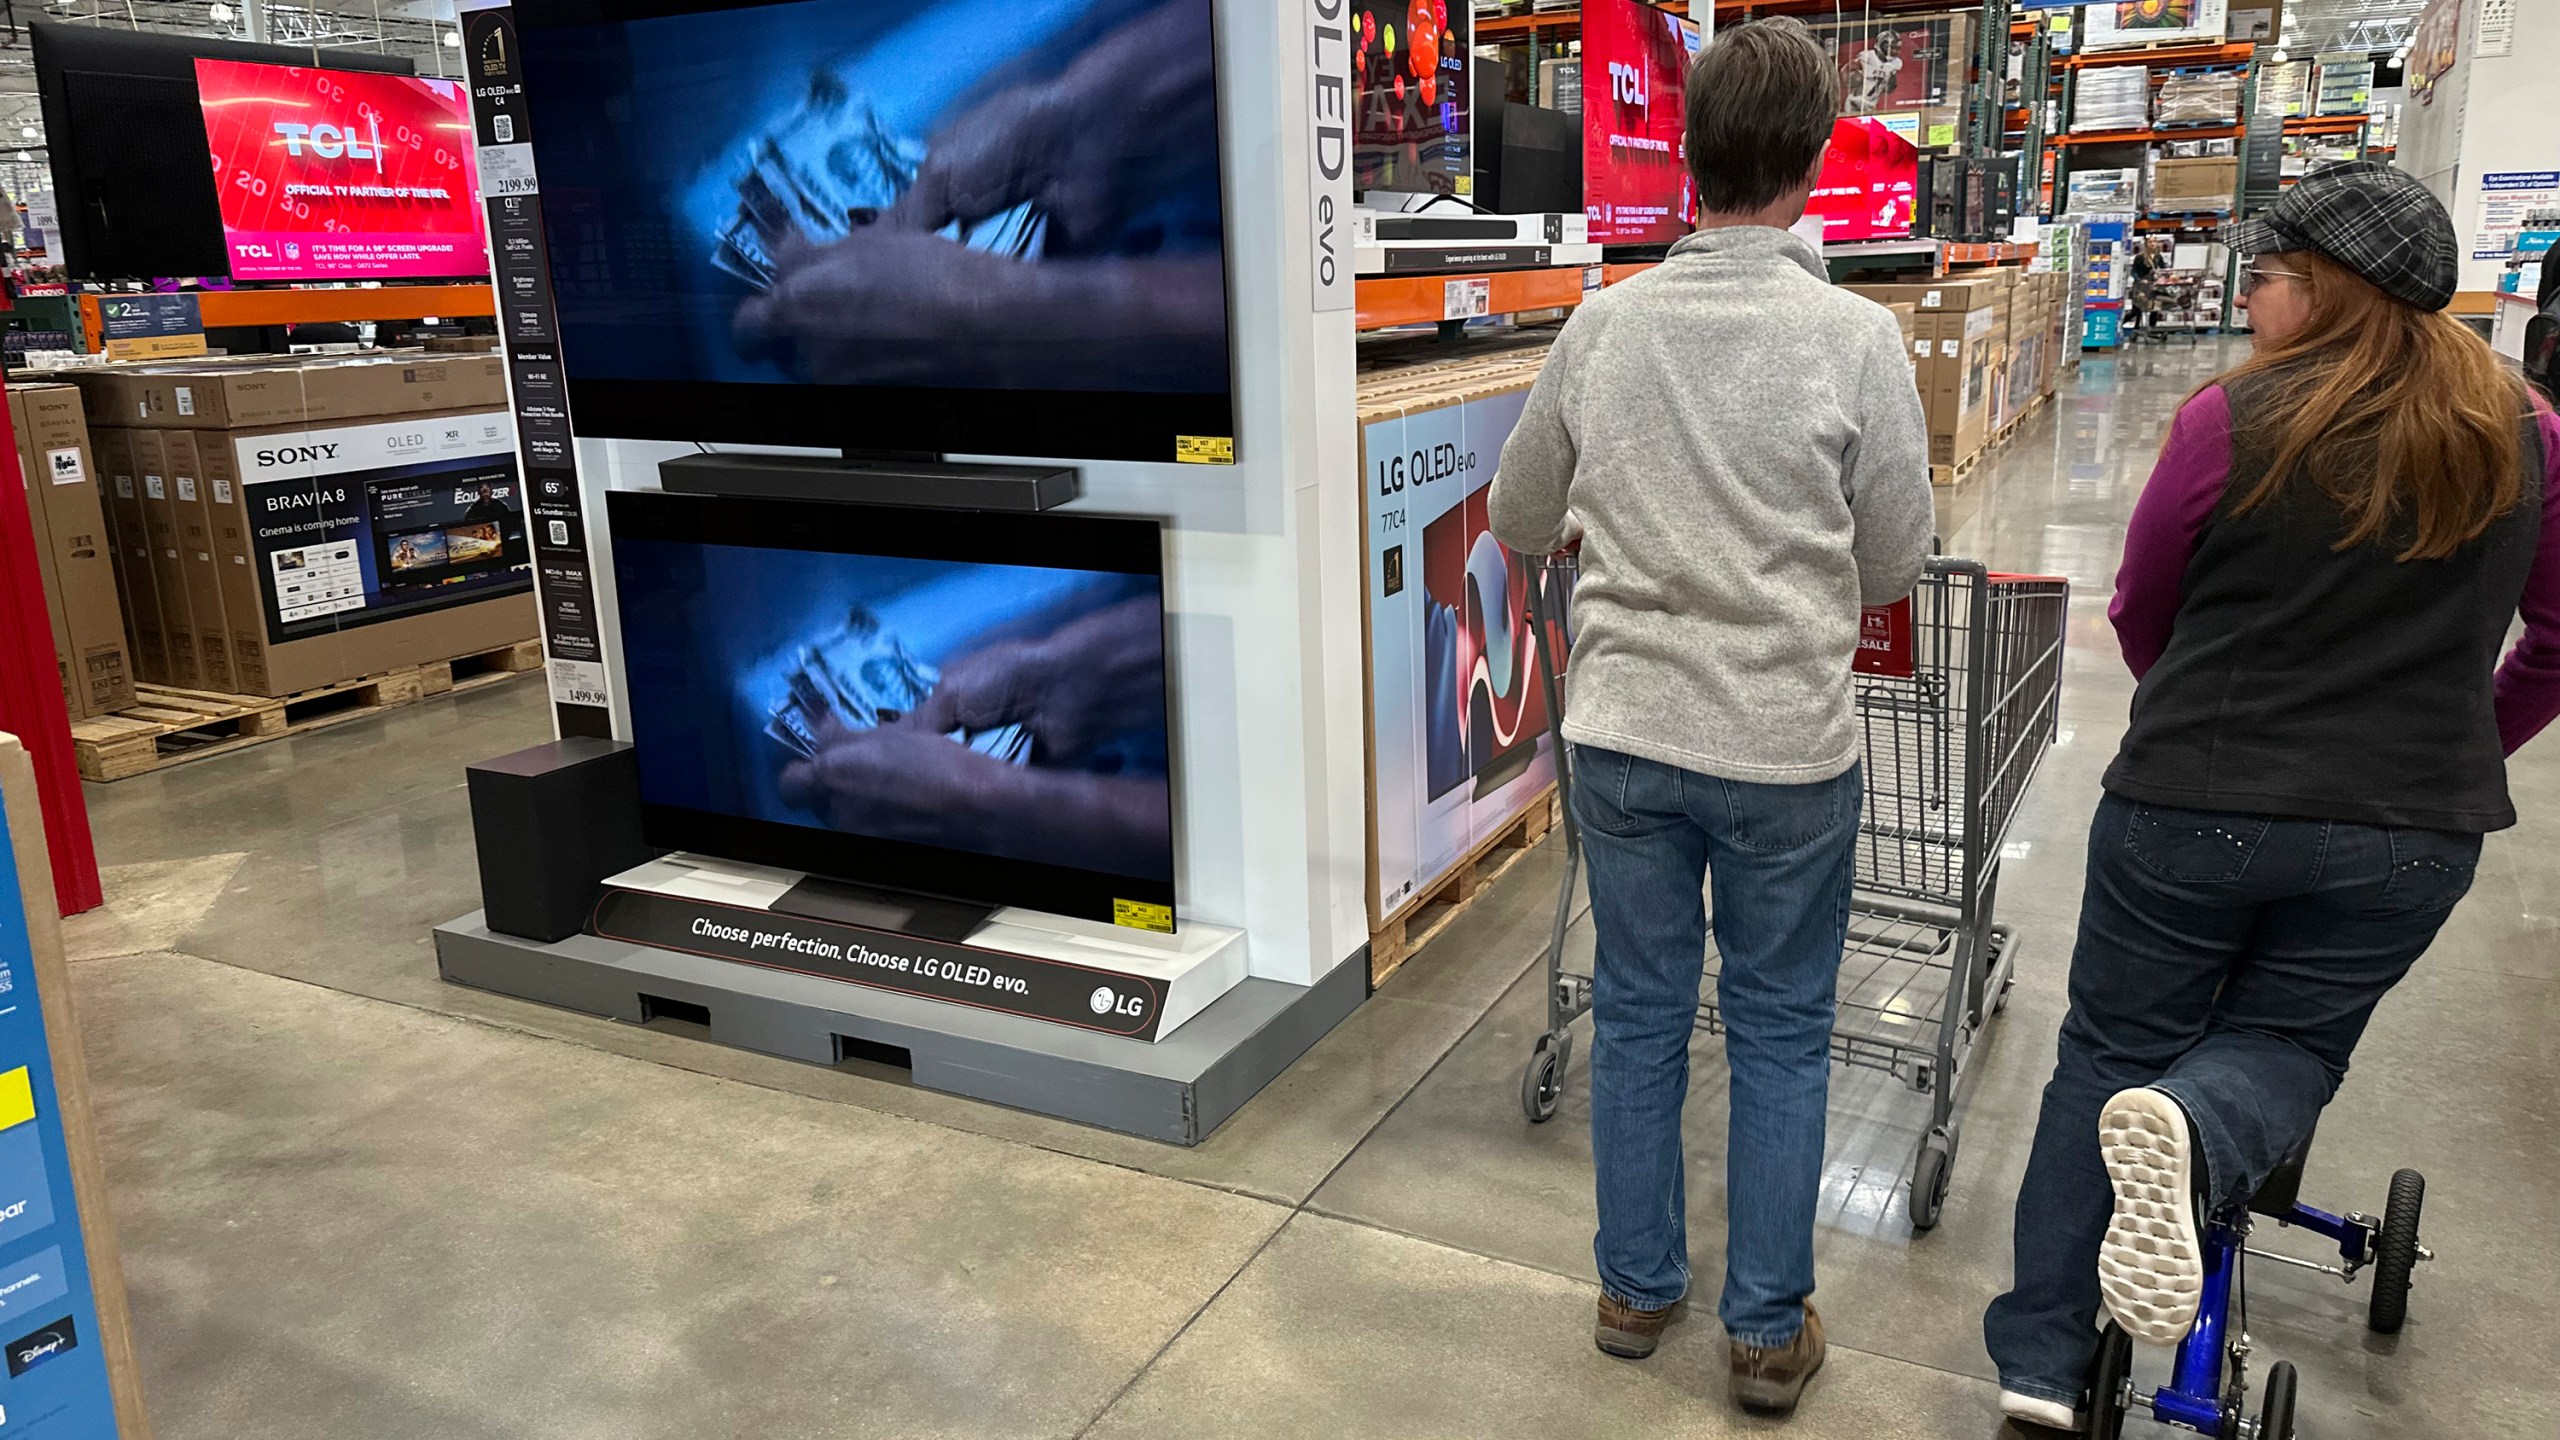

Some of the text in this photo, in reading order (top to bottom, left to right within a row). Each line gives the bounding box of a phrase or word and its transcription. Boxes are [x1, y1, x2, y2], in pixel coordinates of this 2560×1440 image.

[1440, 56, 1462, 71] LG OLED
[1559, 66, 1576, 74] TCL
[476, 88, 486, 97] LG
[487, 86, 505, 96] OLED
[1608, 61, 1644, 106] TCL
[273, 122, 374, 159] TCL
[235, 170, 267, 196] 20
[285, 184, 333, 195] OFFICIAL
[334, 186, 348, 196] TV
[350, 186, 394, 197] PARTNER
[396, 187, 409, 198] OF
[499, 177, 537, 193] 2199.99
[281, 195, 309, 219] 30
[1586, 205, 1602, 221] TCL
[312, 244, 326, 252] IT'S
[387, 244, 416, 252] SCREEN
[1318, 194, 1335, 287] evo
[235, 245, 273, 258] TCL
[375, 252, 398, 260] OFFER
[25, 287, 66, 296] Lenovo
[236, 383, 266, 391] SONY
[387, 434, 424, 448] OLED
[445, 430, 459, 439] XR
[257, 443, 338, 467] SONY
[1380, 442, 1476, 496] LG OLED evo
[545, 482, 560, 494] 65"
[267, 489, 345, 511] BRAVIA 8
[259, 516, 360, 537] Cinema is coming home
[1382, 508, 1406, 533] 77C4
[569, 690, 606, 704] 1499.99
[691, 917, 1029, 995] Choose perfection. Choose LG OLED evo.
[1115, 994, 1143, 1017] LG
[18, 1338, 65, 1363] Disney+
